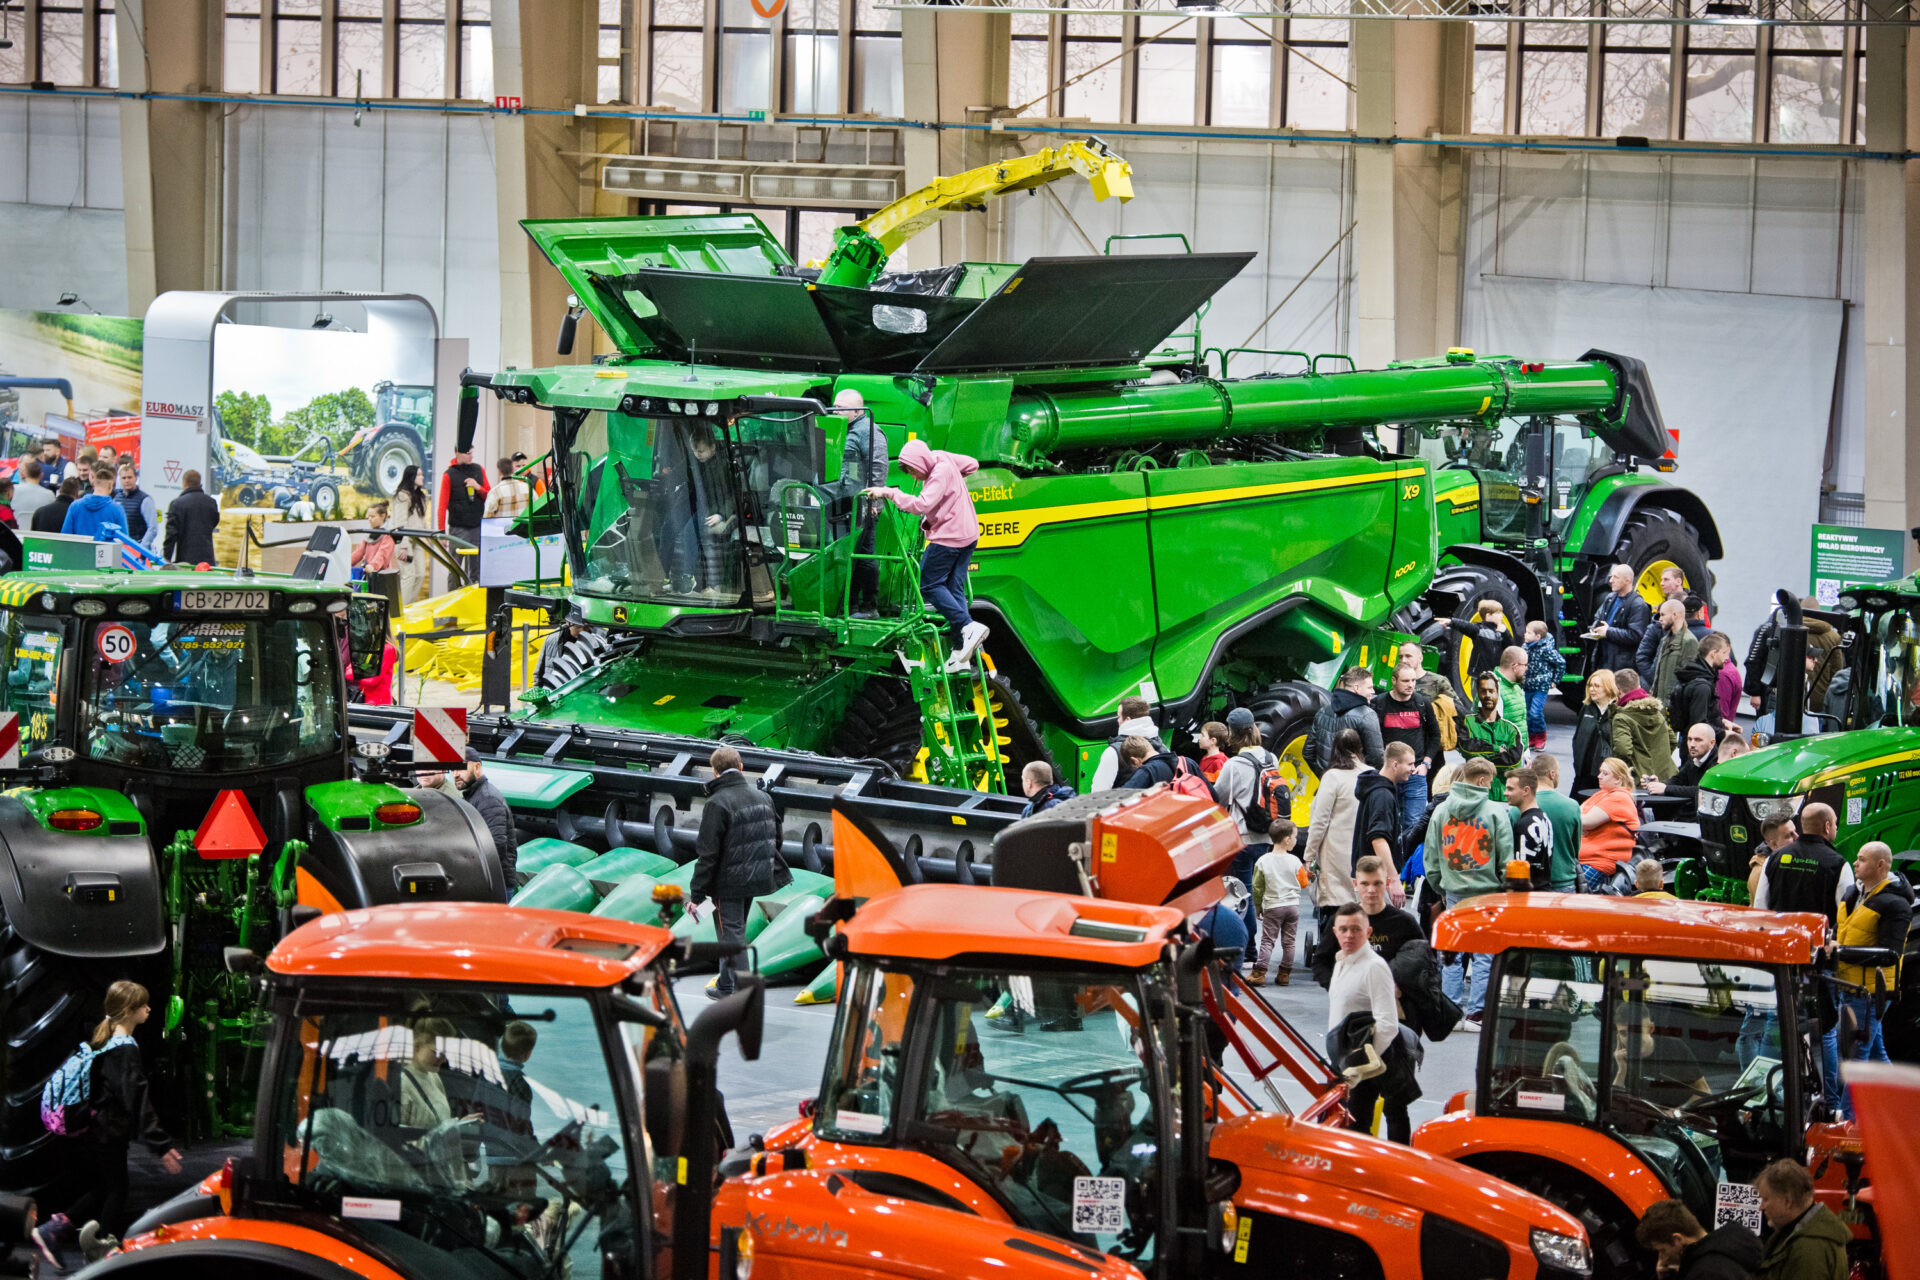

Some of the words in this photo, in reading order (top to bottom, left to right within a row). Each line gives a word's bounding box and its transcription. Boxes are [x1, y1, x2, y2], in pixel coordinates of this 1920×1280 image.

[145, 401, 205, 416] EUROMASZ
[969, 485, 1014, 502] ro-Efekt
[1403, 484, 1420, 500] X9
[28, 551, 53, 564] SIEW
[1394, 560, 1416, 579] 1000
[184, 592, 206, 609] CB
[213, 592, 265, 609] 2P702
[105, 635, 130, 654] 50
[1370, 934, 1389, 942] alvin
[1264, 1141, 1332, 1171] Kubota
[745, 1211, 848, 1247] Kubota
